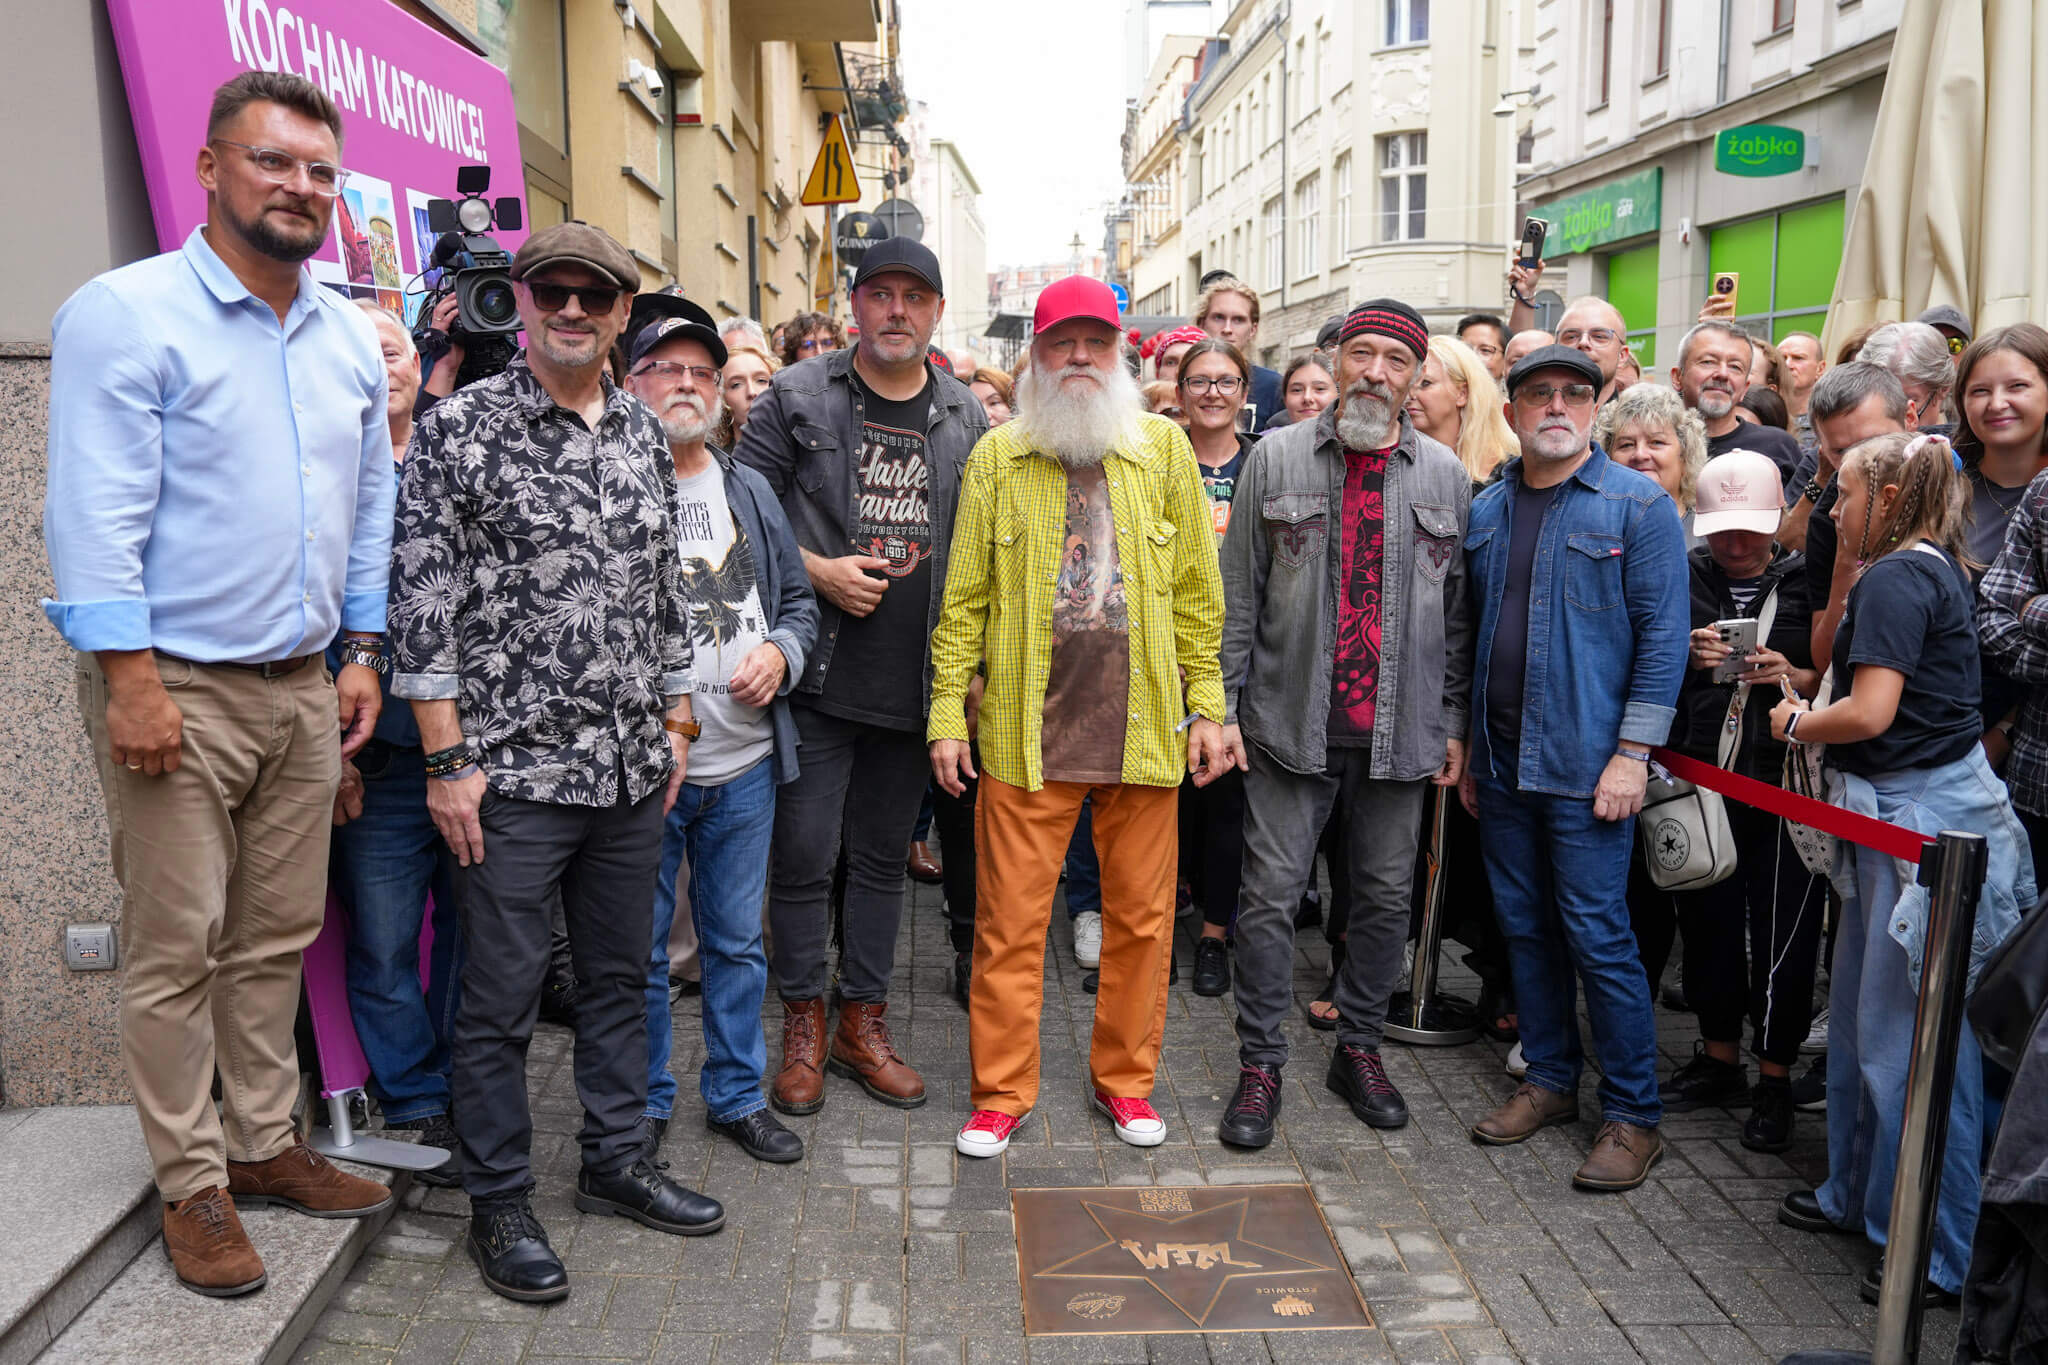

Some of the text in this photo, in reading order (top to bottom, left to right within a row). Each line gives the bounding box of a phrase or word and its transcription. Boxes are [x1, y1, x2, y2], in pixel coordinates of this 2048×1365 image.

[224, 0, 488, 163] KOCHAM KATOWICE!
[1728, 135, 1797, 155] żabka
[1564, 198, 1612, 240] żabka
[837, 235, 882, 248] GUINNE
[885, 546, 907, 559] 1903
[1656, 824, 1682, 842] CONVERSE
